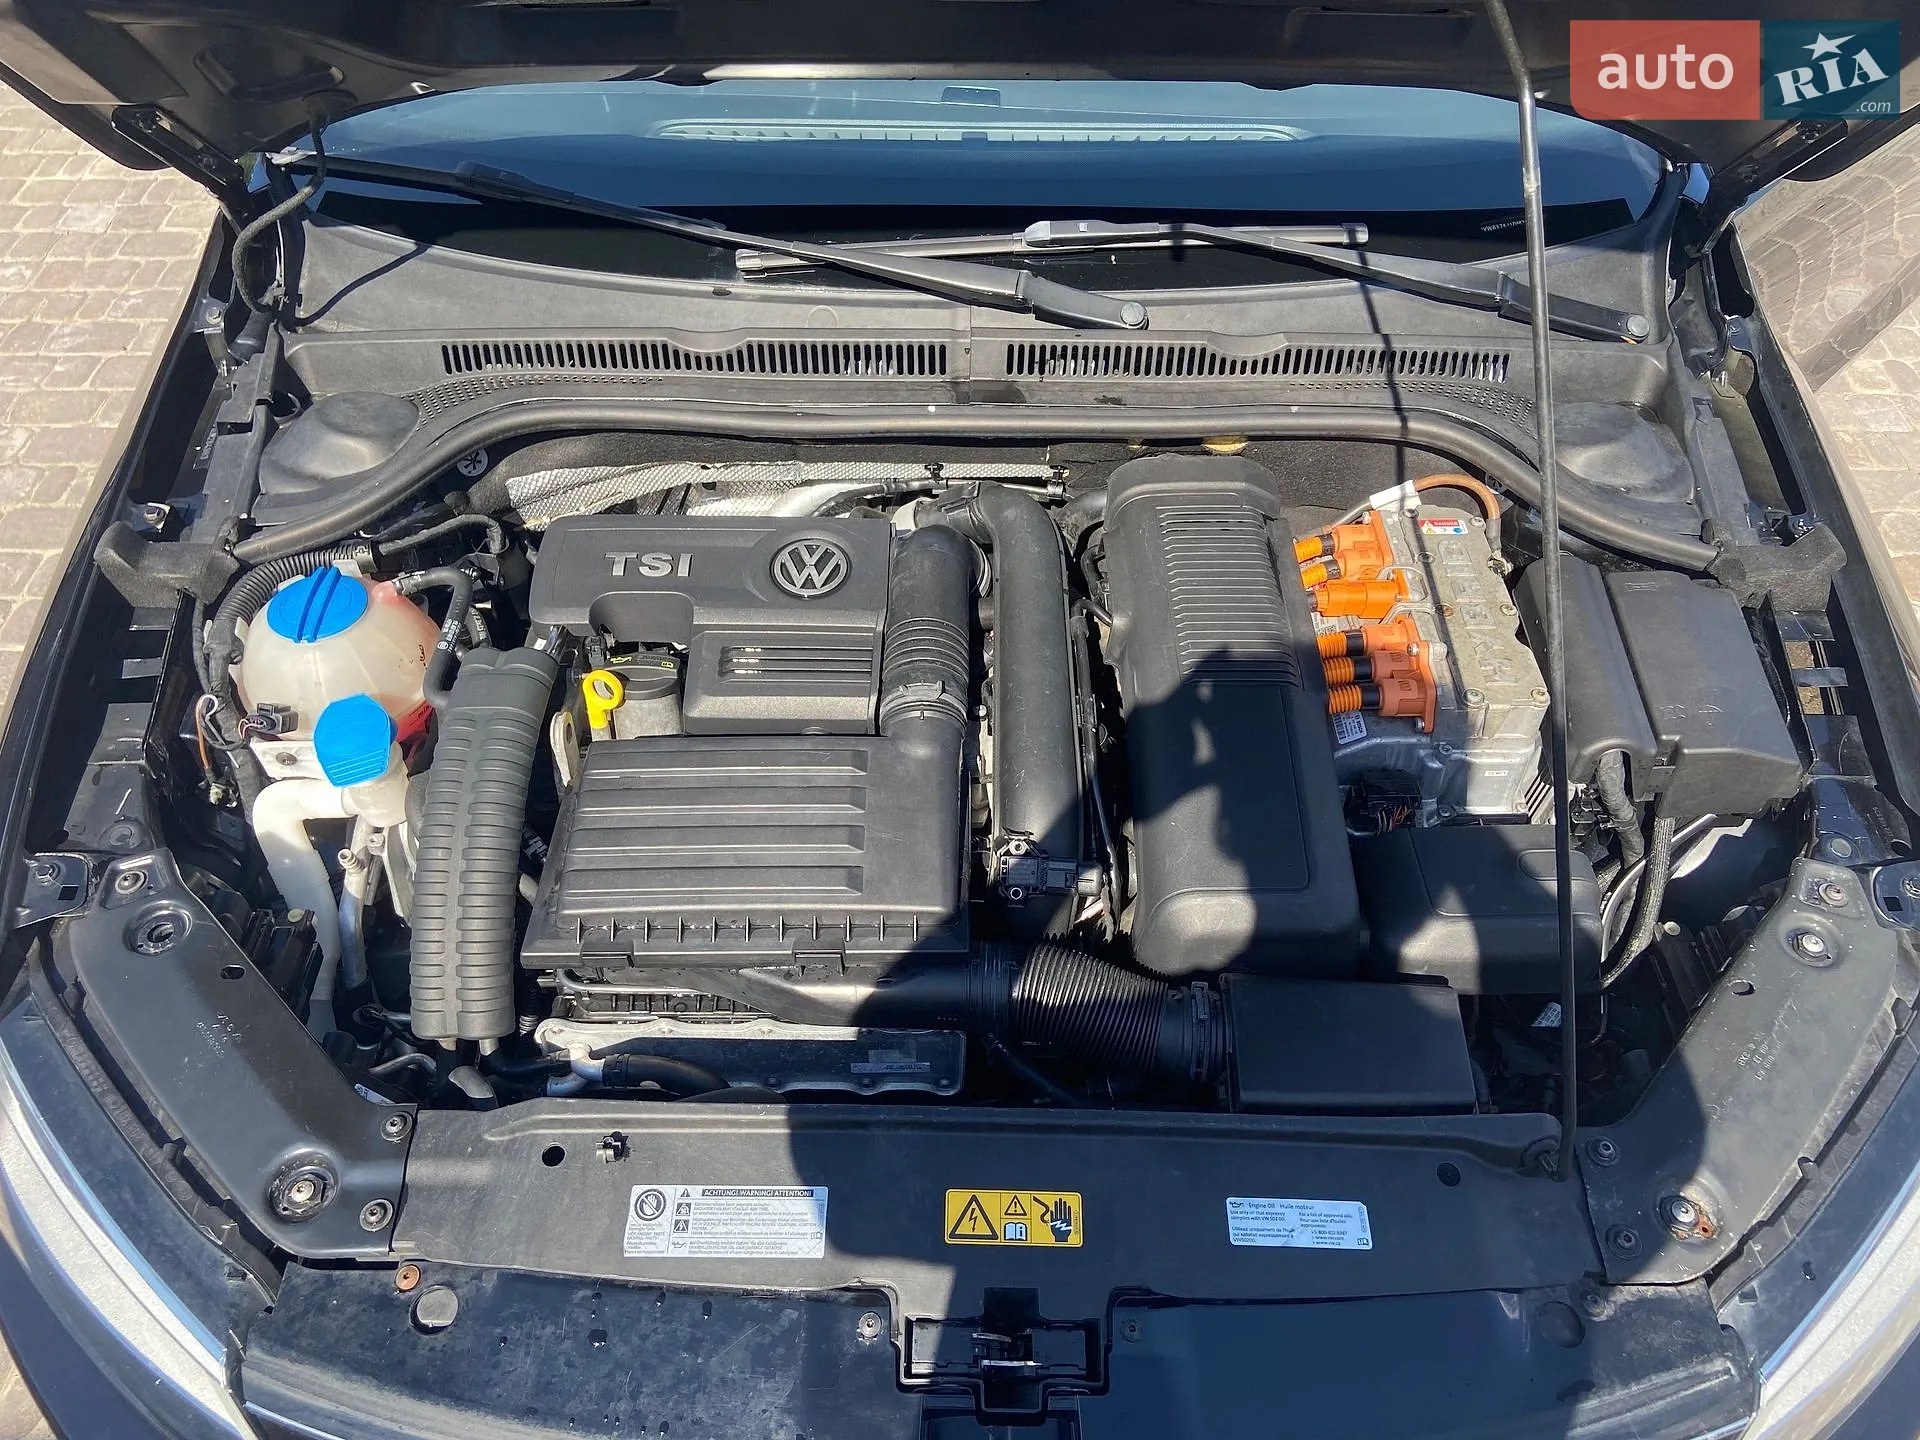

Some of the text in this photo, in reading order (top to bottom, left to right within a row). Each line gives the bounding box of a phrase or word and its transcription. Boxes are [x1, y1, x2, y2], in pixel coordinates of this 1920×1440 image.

[604, 552, 693, 577] TSI
[704, 1189, 739, 1197] ACHTUNG!
[740, 1189, 774, 1197] WARNING!
